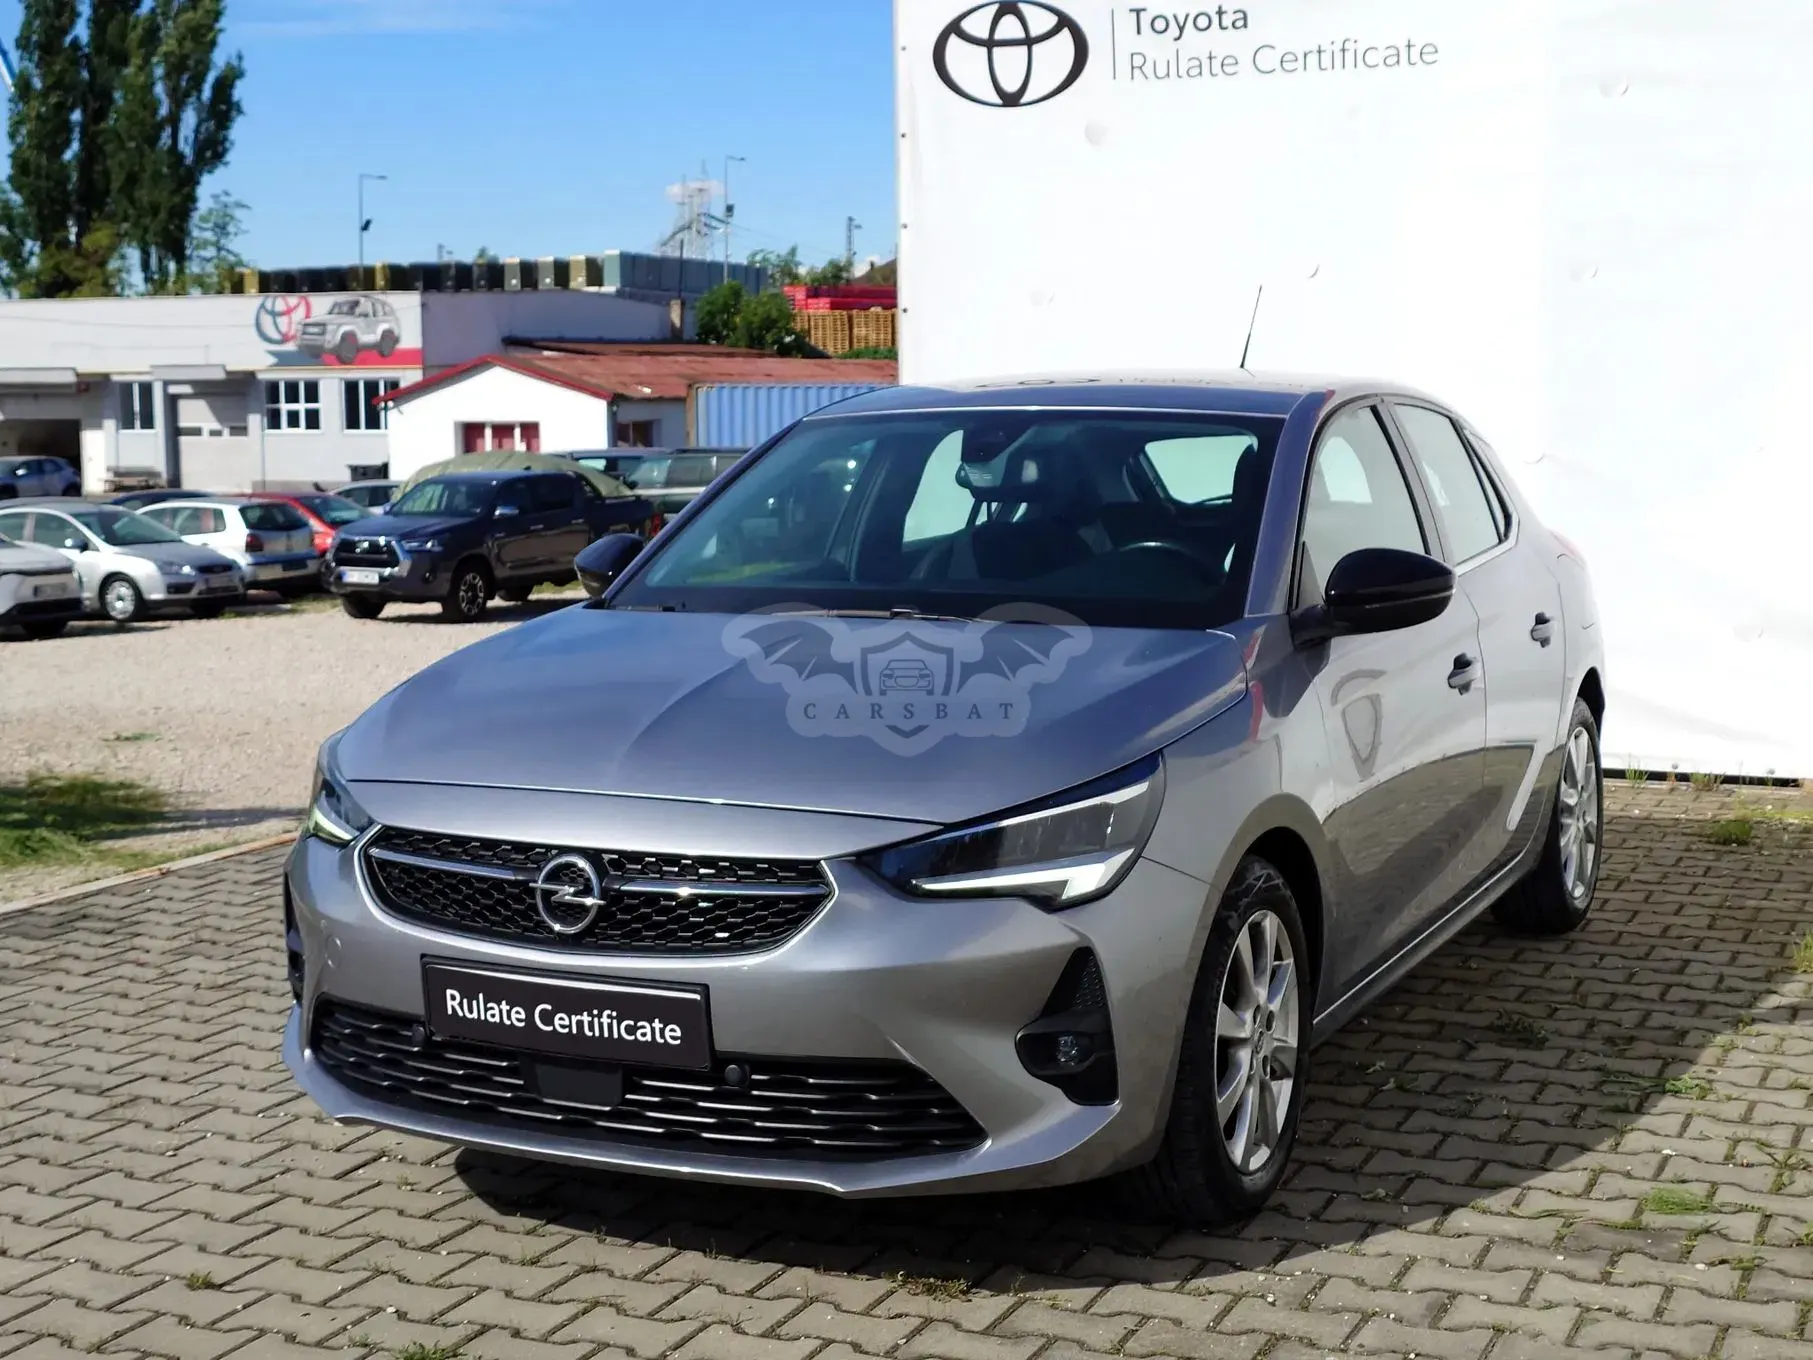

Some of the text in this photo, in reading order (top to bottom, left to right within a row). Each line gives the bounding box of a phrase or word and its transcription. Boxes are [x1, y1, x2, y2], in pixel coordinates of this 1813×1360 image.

[1129, 5, 1249, 41] Toyota
[1130, 38, 1439, 81] Rulate Certificate
[445, 988, 682, 1045] Rulate Certificate
